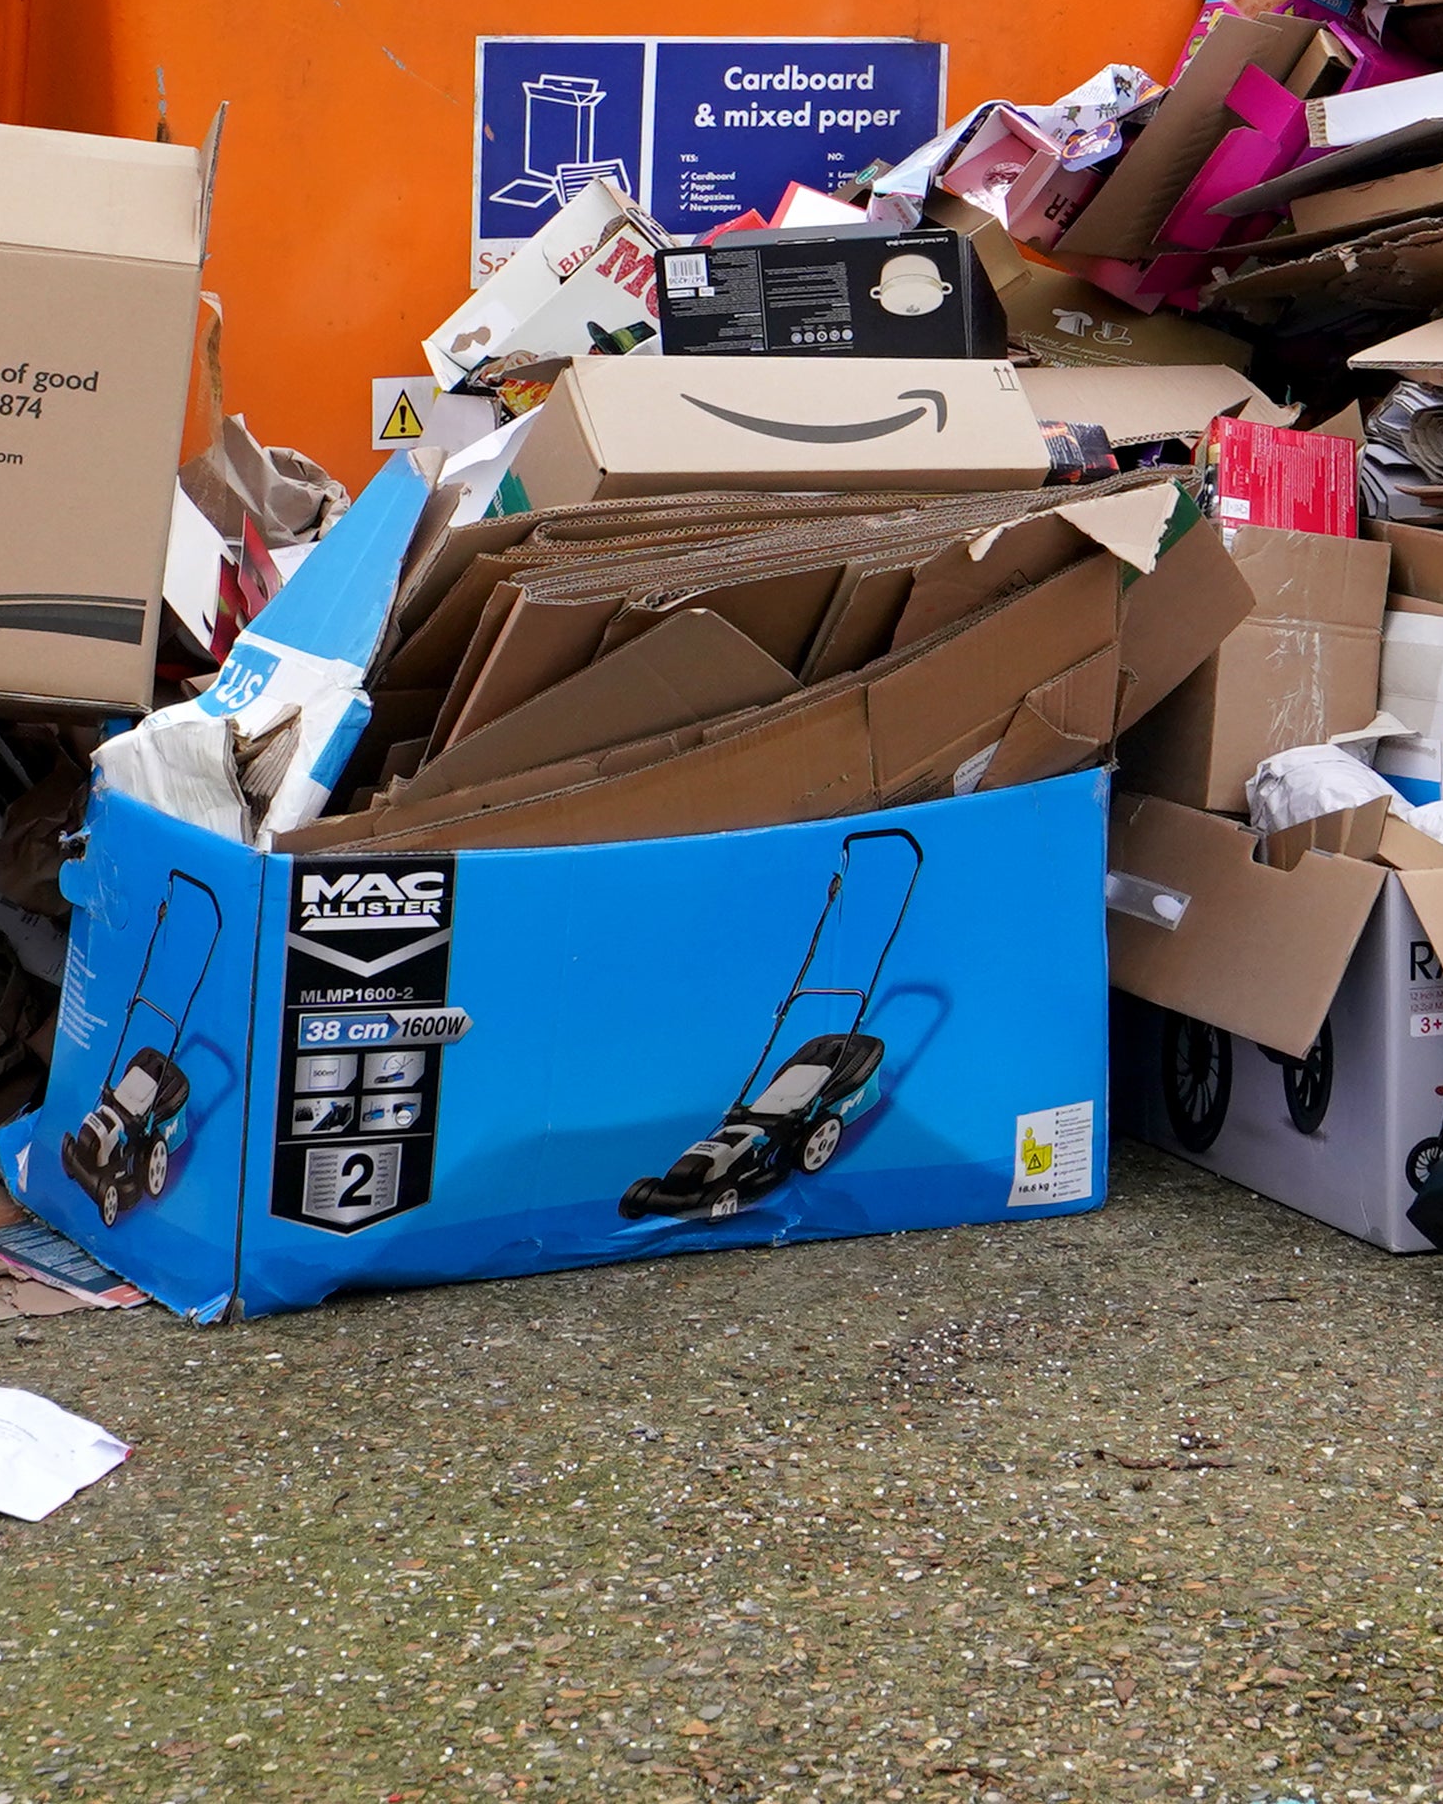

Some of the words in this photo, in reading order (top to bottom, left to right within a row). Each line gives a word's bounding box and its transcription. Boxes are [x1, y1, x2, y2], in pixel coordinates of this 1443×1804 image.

[724, 66, 874, 91] Cardboard
[694, 103, 717, 129] &
[723, 102, 812, 128] mixed
[818, 108, 901, 134] paper
[680, 154, 699, 163] YES:
[827, 153, 845, 161] NO:
[690, 172, 736, 181] Cardboard
[690, 182, 715, 192] Paper
[690, 192, 736, 202] Magazines
[690, 203, 742, 213] Newspapers
[1, 362, 29, 384] of
[33, 370, 100, 393] good
[302, 872, 445, 902] MAC
[300, 900, 442, 917] ALLISTER
[300, 988, 414, 1004] MLMP1600-2
[306, 1021, 342, 1041] 38
[348, 1022, 389, 1040] cm
[400, 1016, 466, 1037] 1600W
[1421, 1017, 1443, 1033] 3+
[338, 1153, 375, 1208] 2
